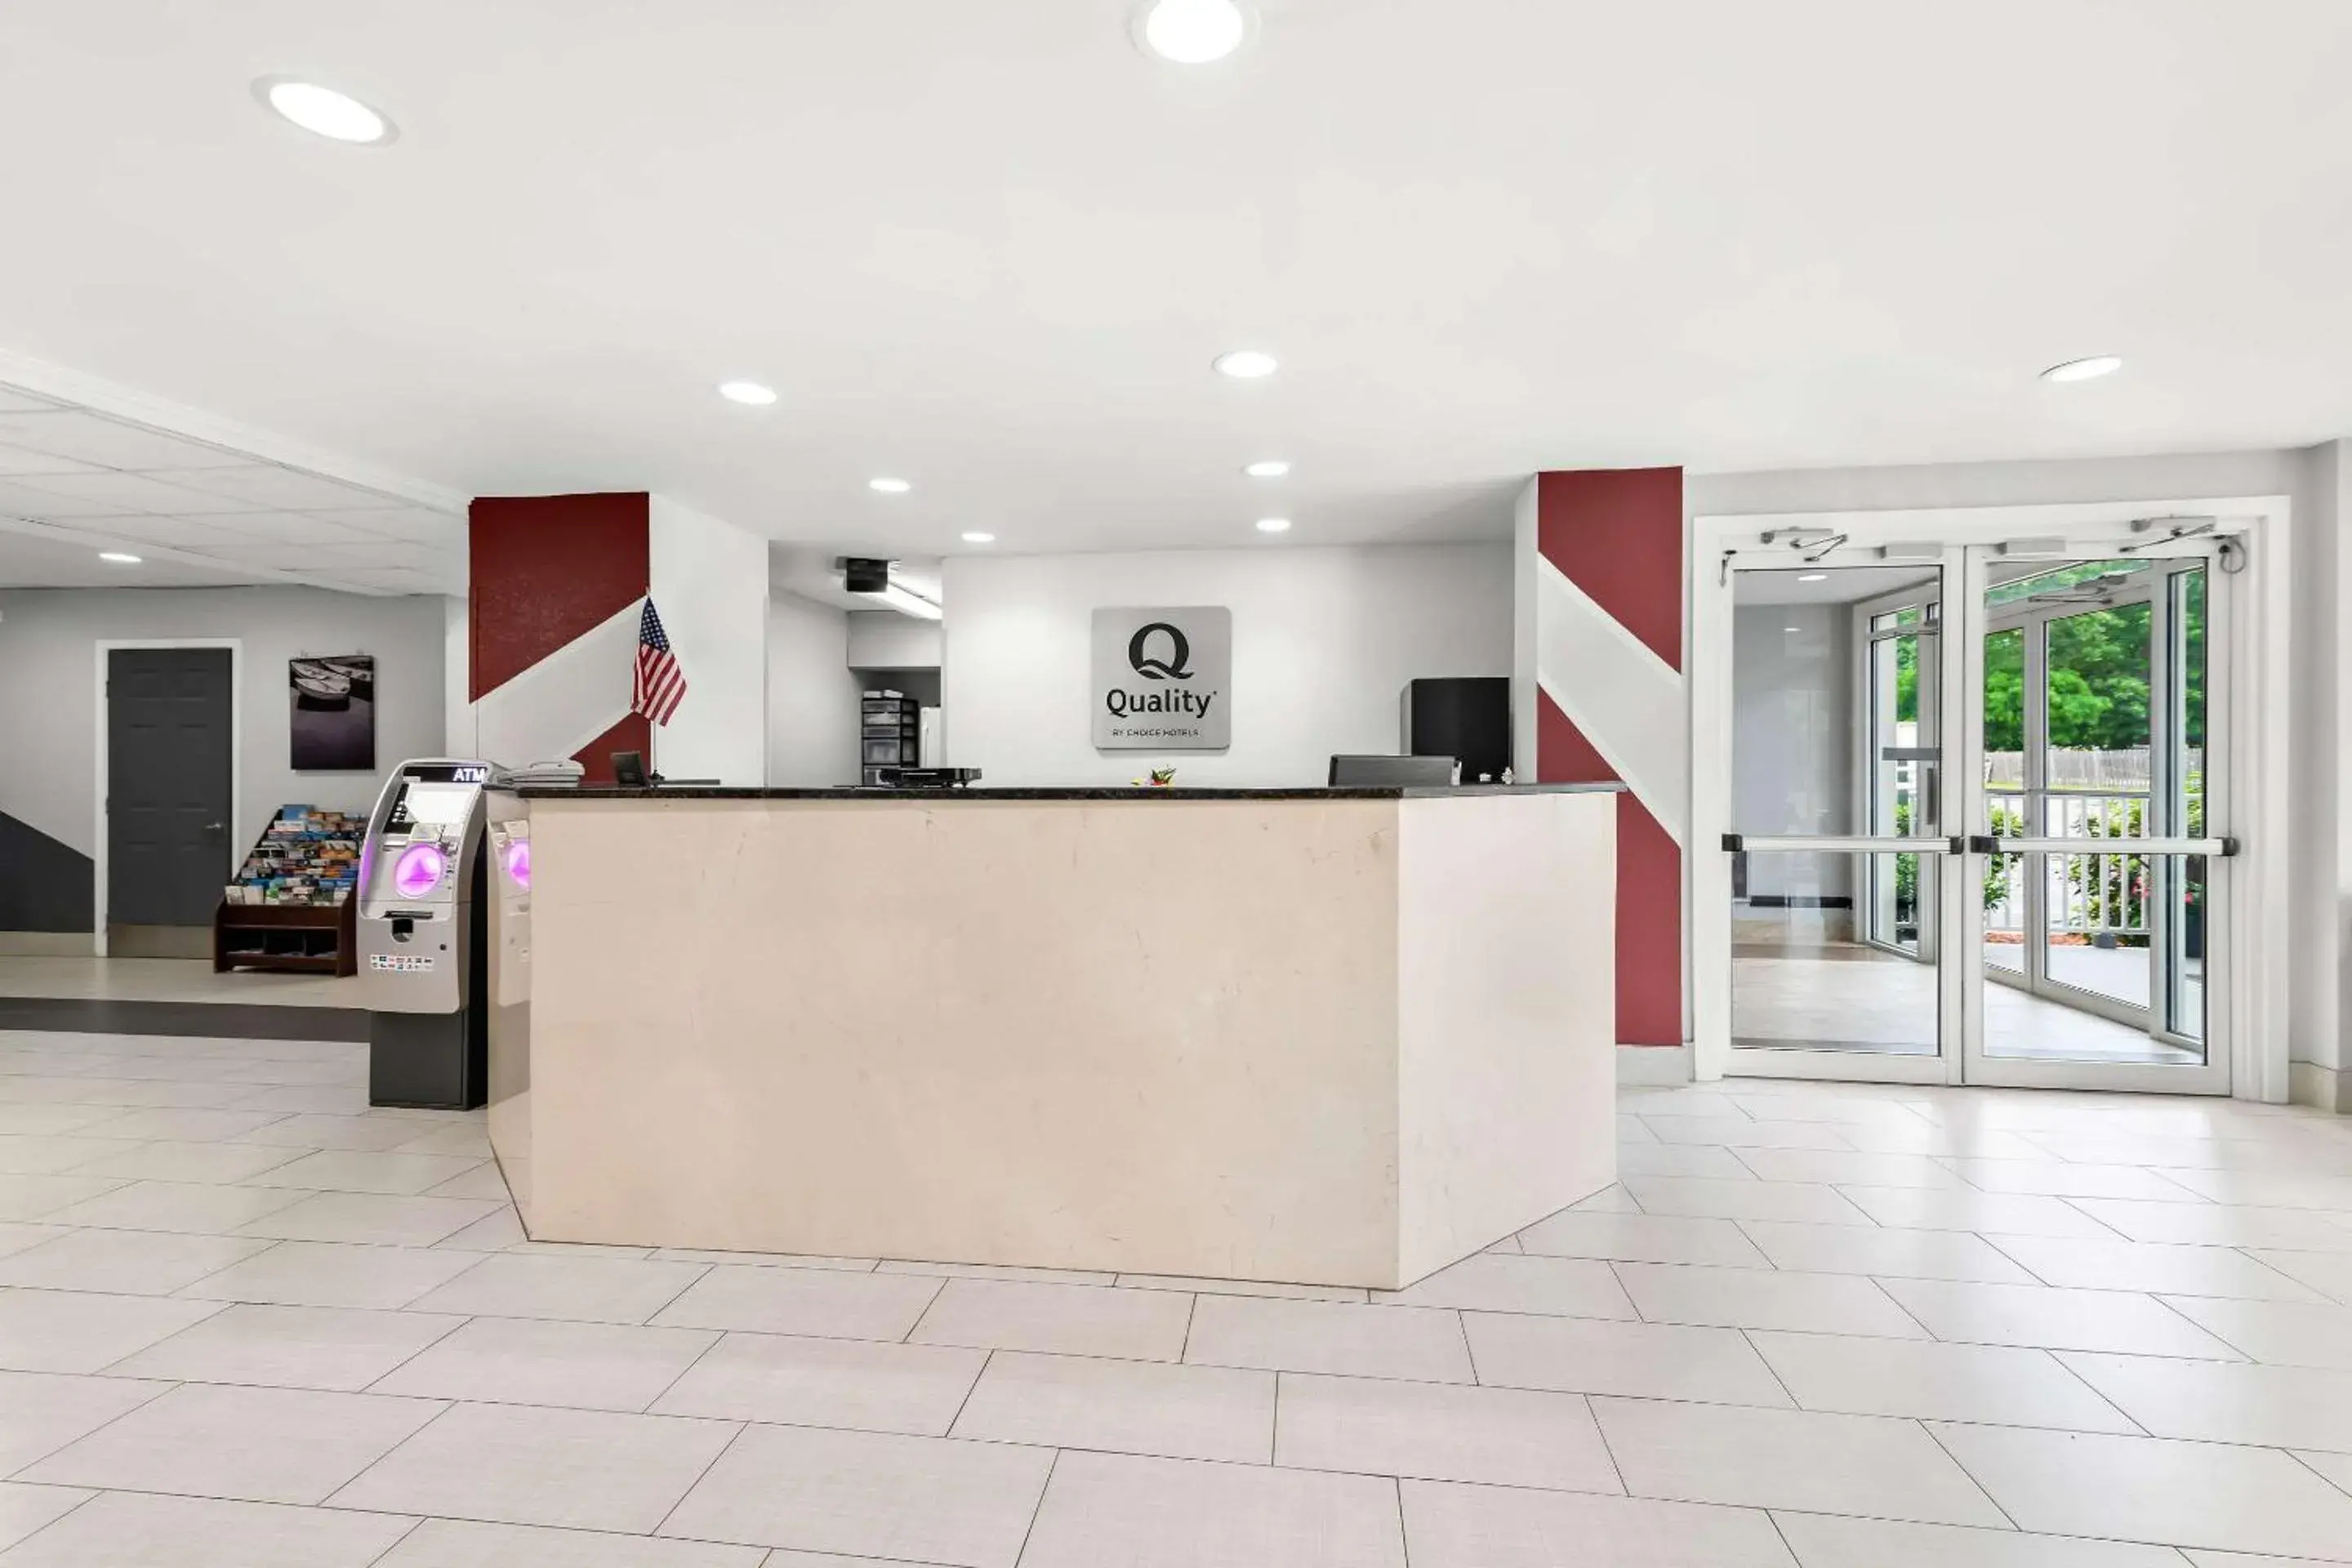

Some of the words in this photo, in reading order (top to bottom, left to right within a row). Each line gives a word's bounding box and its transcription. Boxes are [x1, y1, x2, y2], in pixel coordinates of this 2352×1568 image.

[1129, 622, 1194, 679] Q
[1107, 688, 1212, 719] Quality
[1127, 728, 1160, 736] CHOICE
[1162, 728, 1199, 736] HOTELS
[452, 768, 484, 782] ATM
